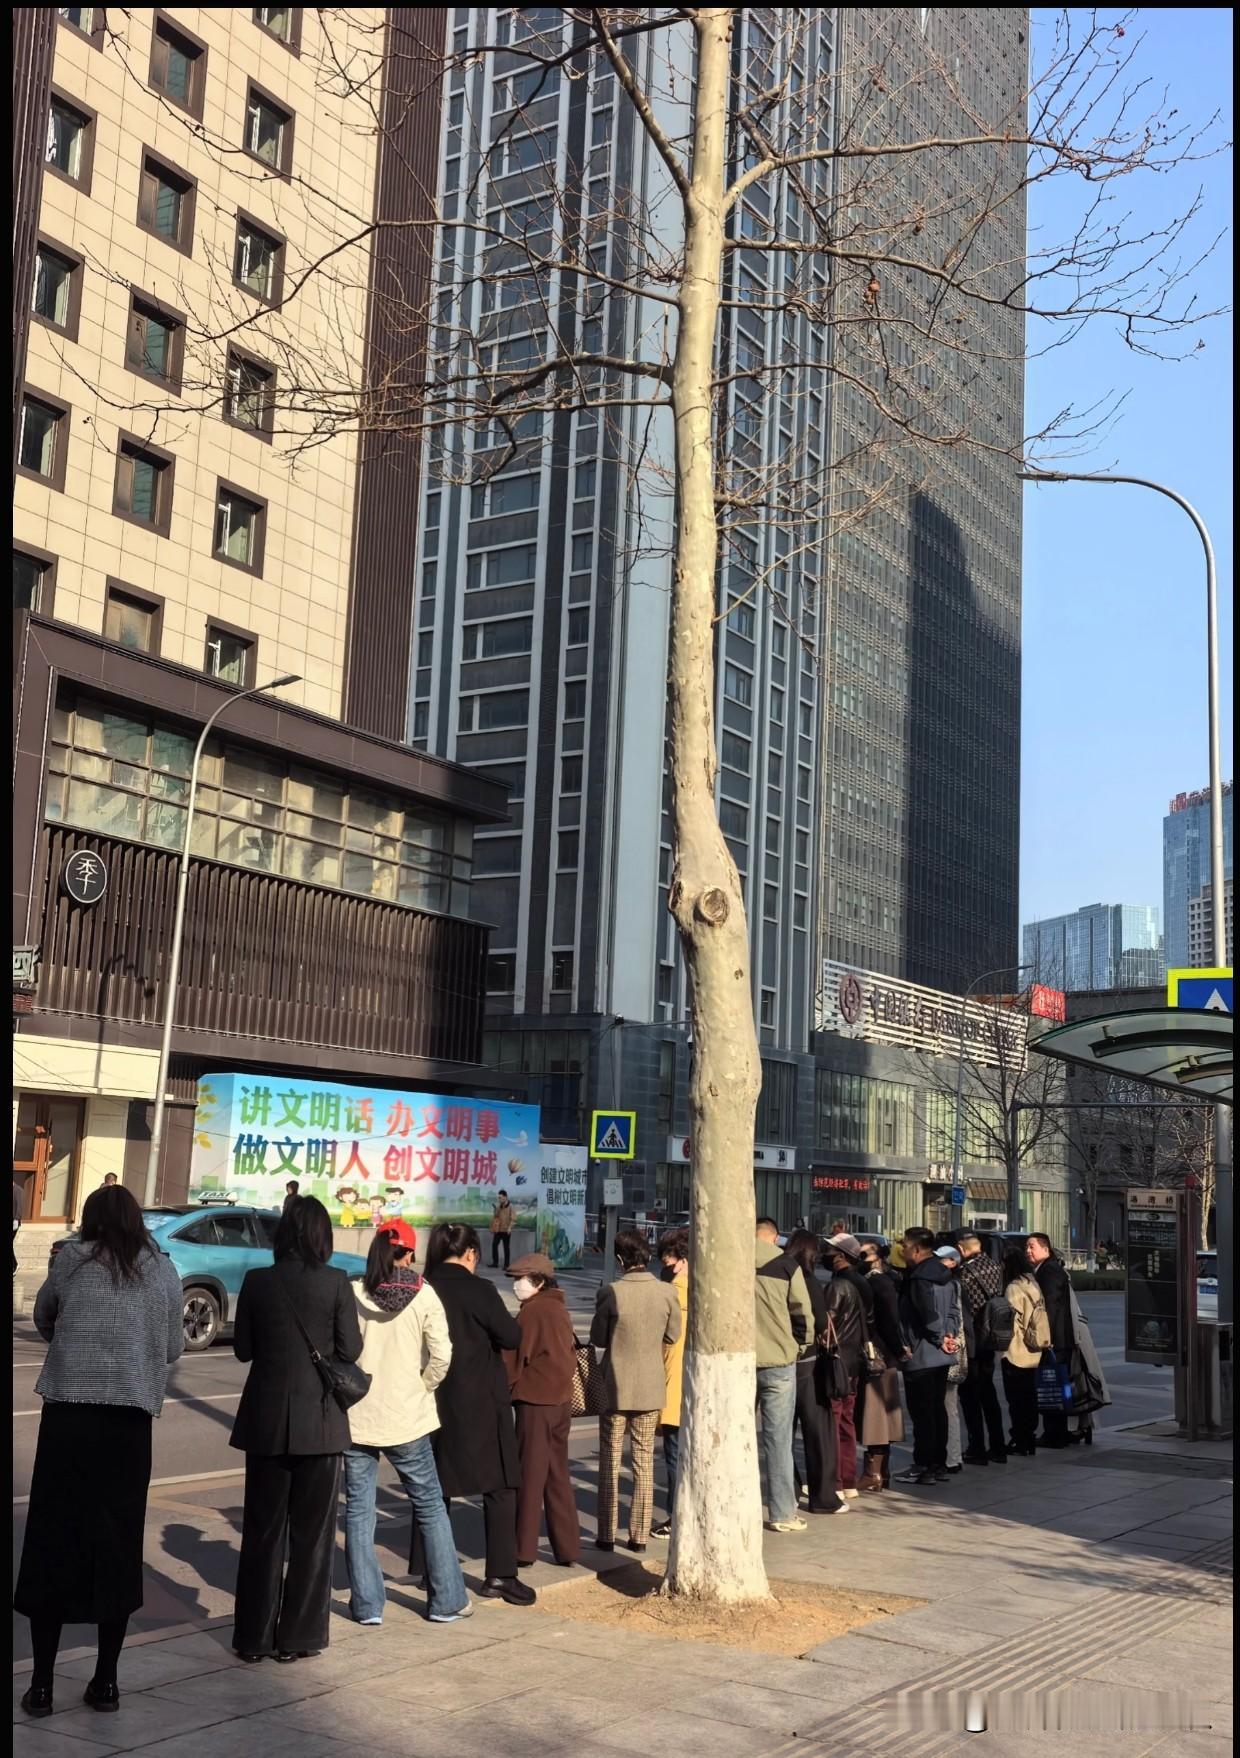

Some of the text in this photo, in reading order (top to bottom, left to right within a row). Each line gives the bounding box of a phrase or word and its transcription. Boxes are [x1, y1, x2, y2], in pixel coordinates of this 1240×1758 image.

[75, 857, 98, 895] 季
[239, 1085, 500, 1143] 讲文明话 办文明事
[233, 1133, 498, 1186] 做文明人 创文明城
[546, 1188, 586, 1206] 倡树文明新
